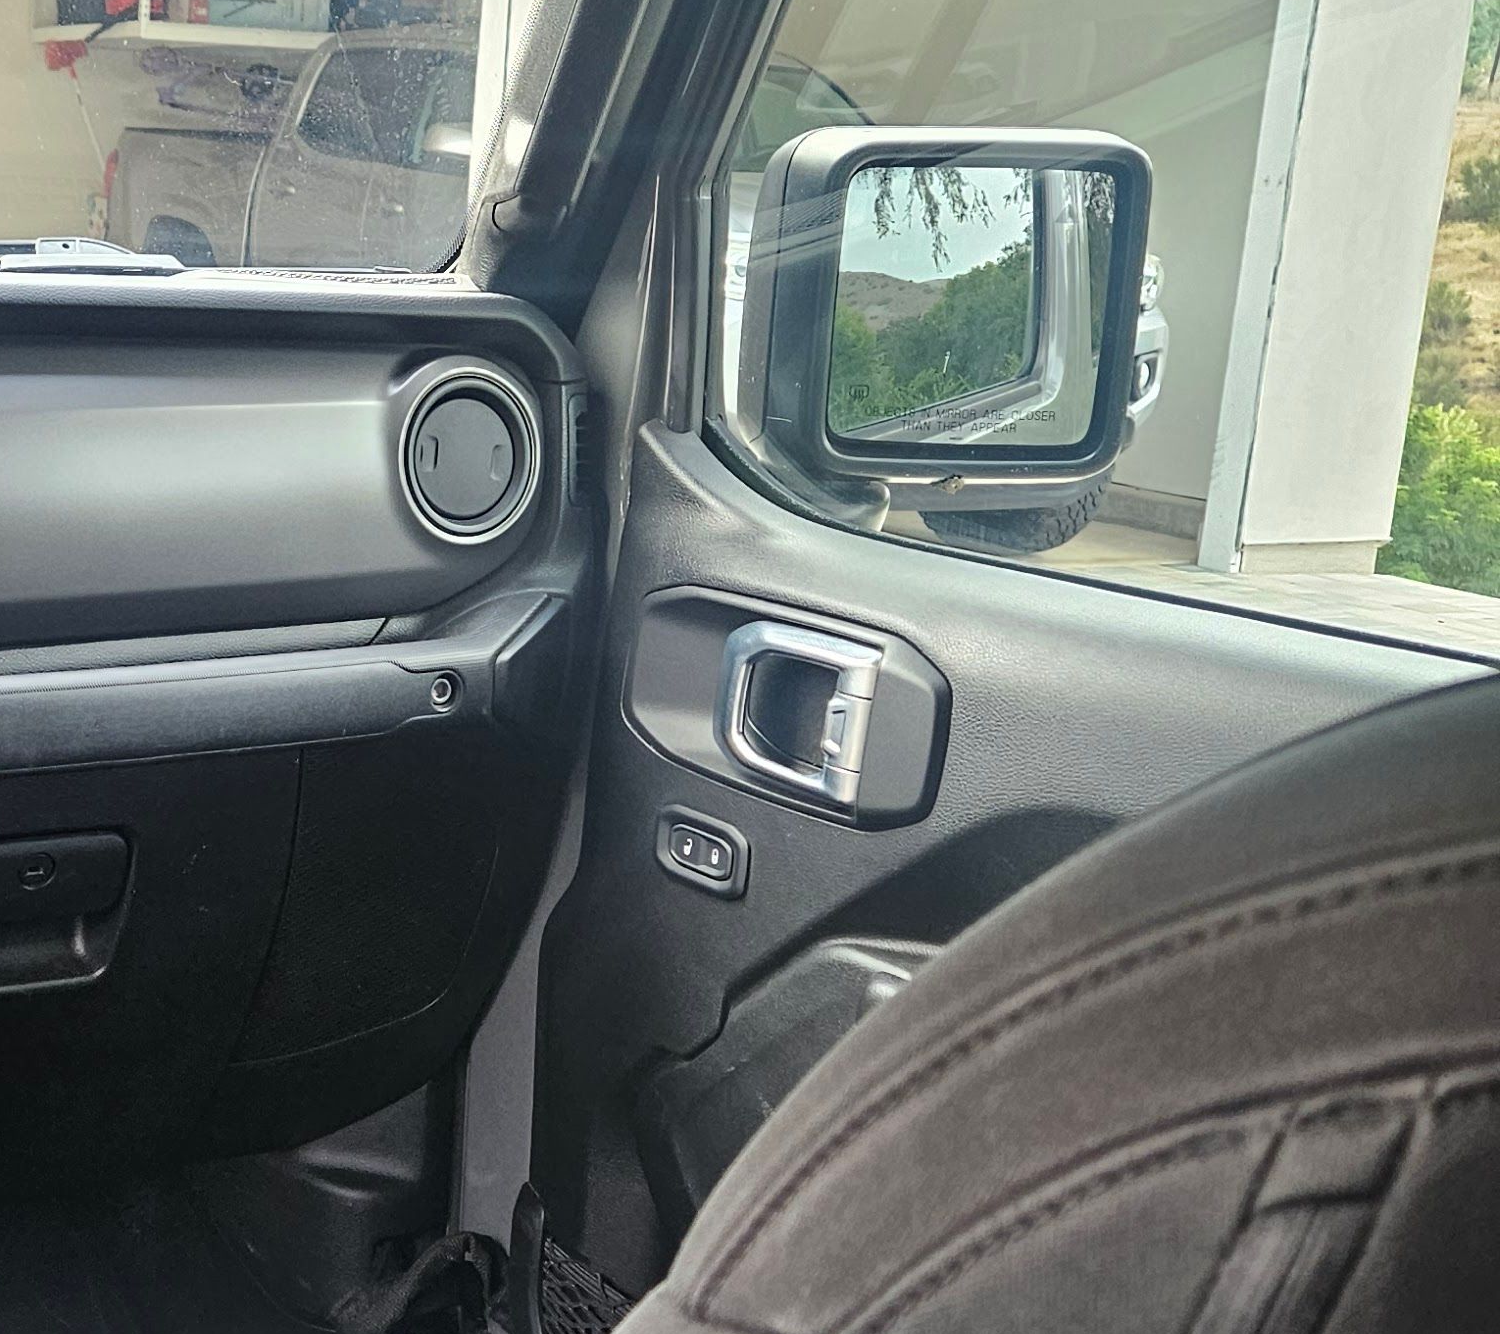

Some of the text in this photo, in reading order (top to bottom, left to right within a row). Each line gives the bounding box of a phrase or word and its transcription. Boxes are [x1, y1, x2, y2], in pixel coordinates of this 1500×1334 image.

[863, 406, 916, 418] OBJECTS
[933, 407, 977, 420] MIRROR
[982, 408, 1005, 420] ARE
[1011, 410, 1056, 422] CLOSER
[901, 420, 1017, 434] THAN THEY APPEAR
